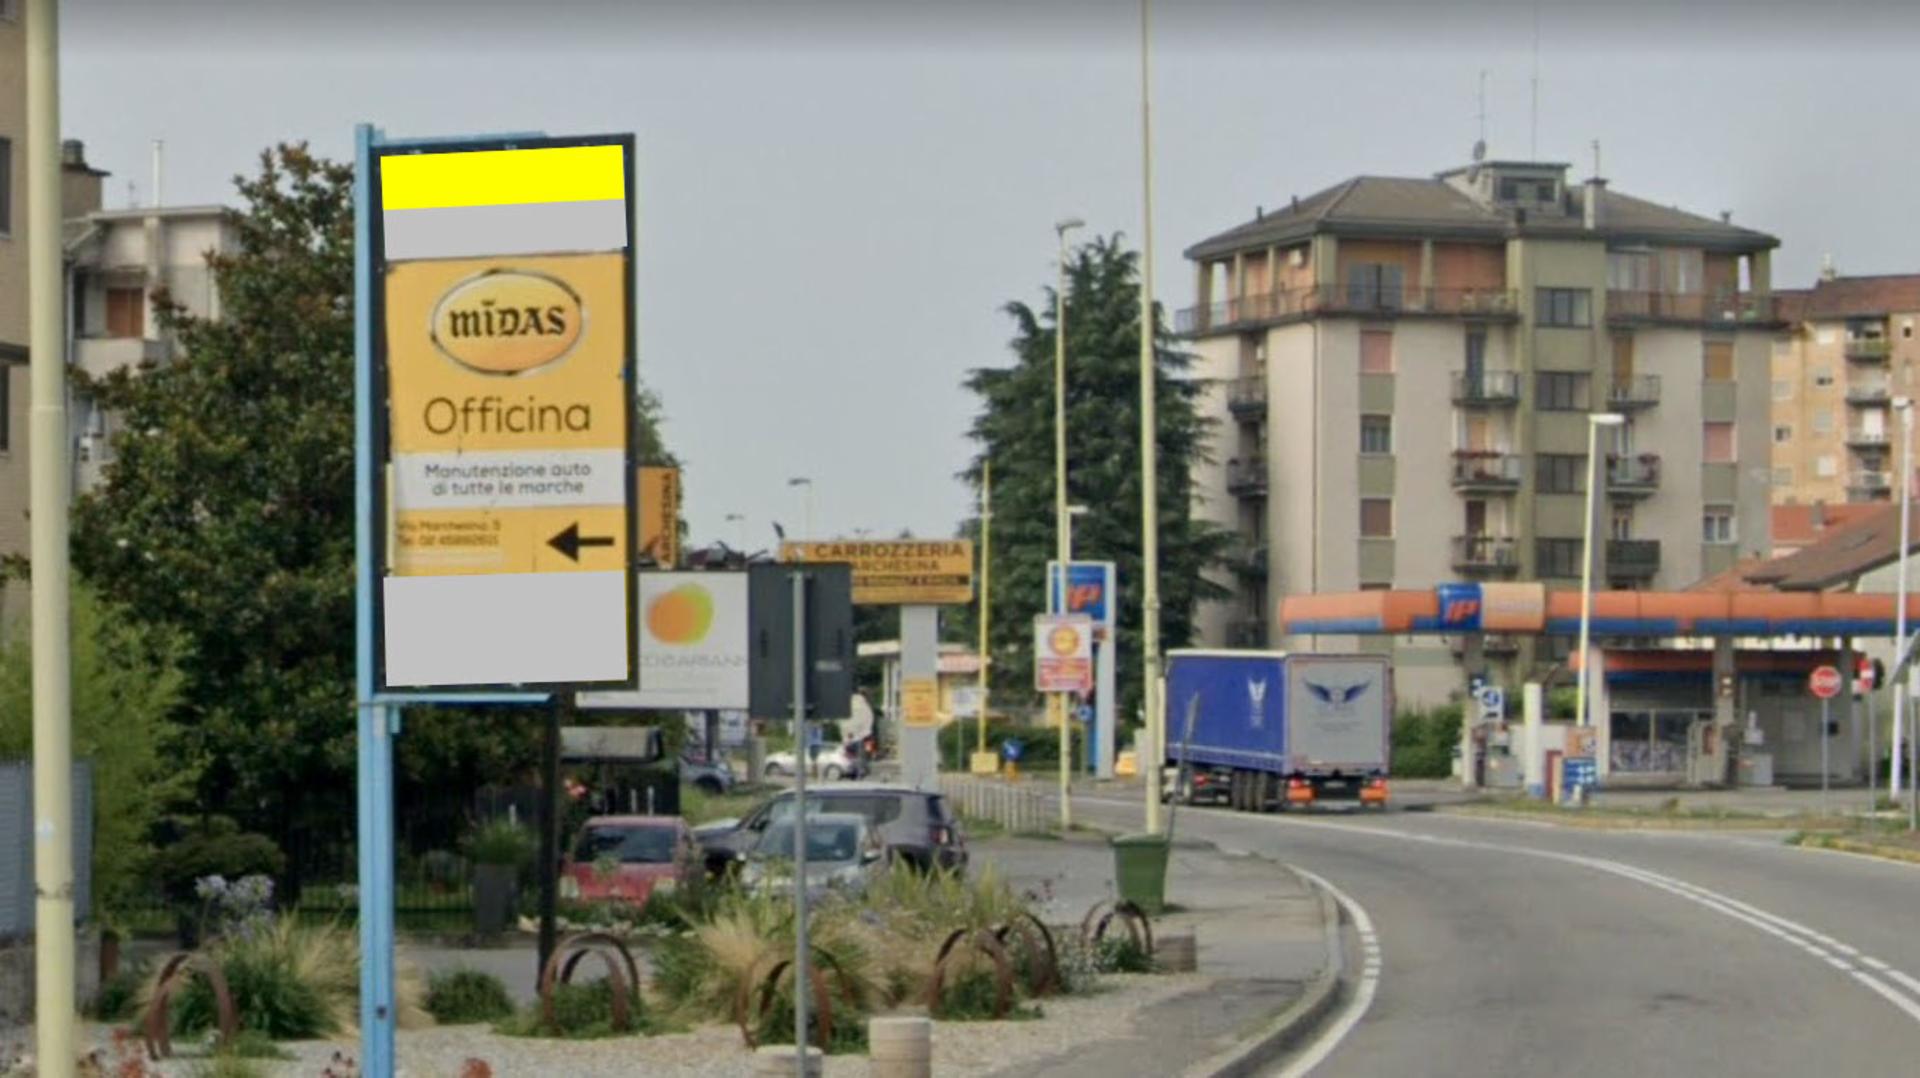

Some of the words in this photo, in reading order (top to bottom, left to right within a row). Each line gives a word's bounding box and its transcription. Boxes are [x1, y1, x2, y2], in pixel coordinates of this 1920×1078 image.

[424, 395, 591, 435] Officina
[425, 462, 546, 478] Manutenzione
[551, 462, 592, 476] auto
[432, 483, 447, 496] di
[452, 481, 494, 495] tutte
[499, 481, 514, 494] le
[519, 479, 584, 494] marche
[815, 542, 965, 558] CARROZZERIA
[852, 558, 940, 571] ARCHESINA
